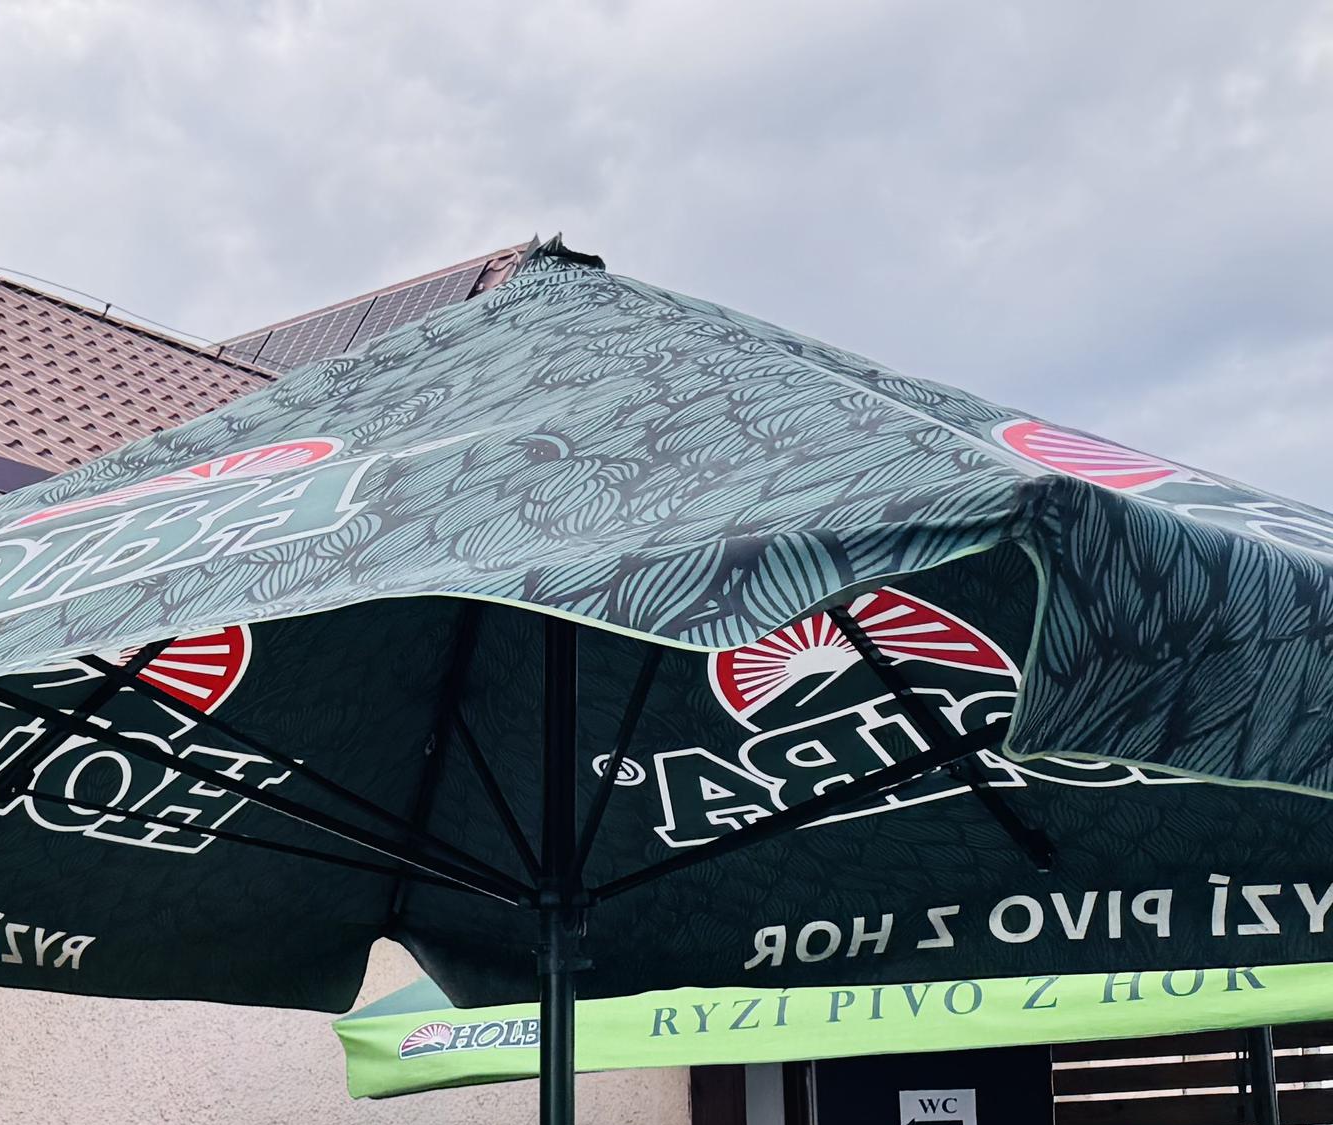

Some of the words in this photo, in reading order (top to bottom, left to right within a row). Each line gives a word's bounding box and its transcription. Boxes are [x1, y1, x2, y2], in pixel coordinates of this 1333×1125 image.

[650, 988, 791, 1037] RYZÍ
[826, 980, 983, 1023] PIVO
[1022, 975, 1063, 1010] Z
[1099, 965, 1267, 1003] HOR
[918, 1097, 958, 1114] WC
